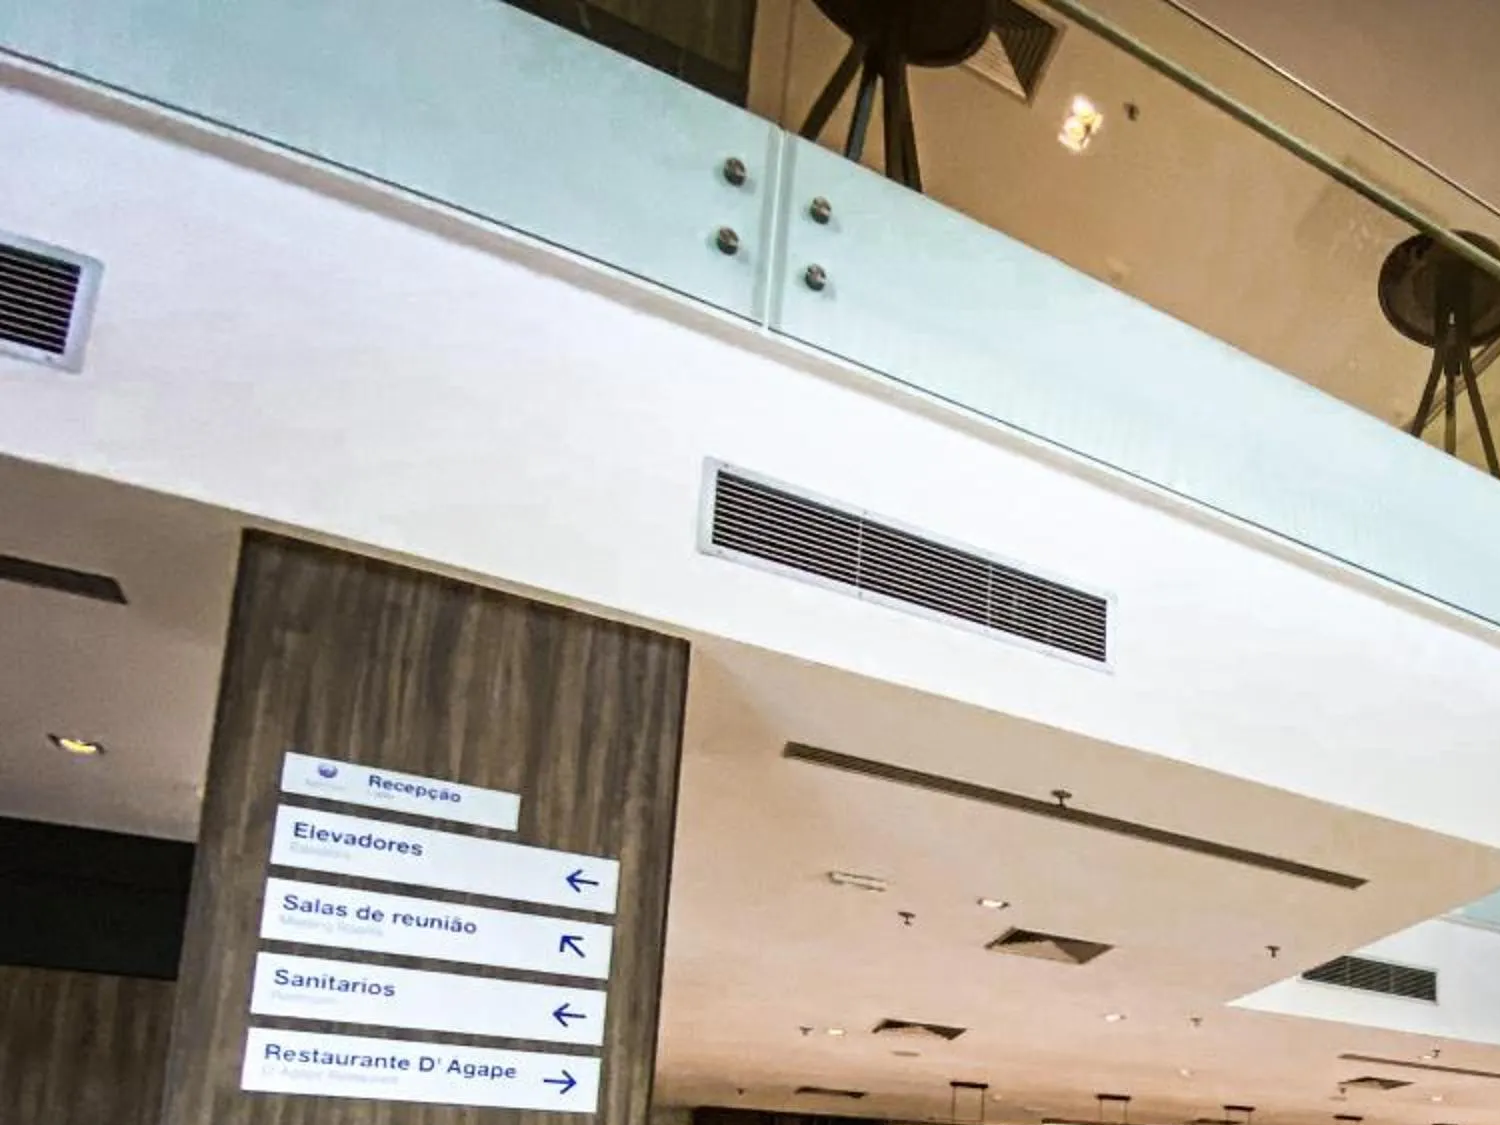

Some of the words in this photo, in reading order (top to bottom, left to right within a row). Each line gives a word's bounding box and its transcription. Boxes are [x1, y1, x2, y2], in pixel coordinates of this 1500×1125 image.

[368, 774, 461, 803] Recepção
[293, 821, 424, 857] Elevadores
[282, 894, 348, 917] Salas
[355, 905, 385, 922] de
[392, 911, 477, 934] reunião
[274, 968, 396, 997] Sanitarios
[264, 1043, 411, 1071] Restaurante
[447, 1058, 518, 1080] Agape
